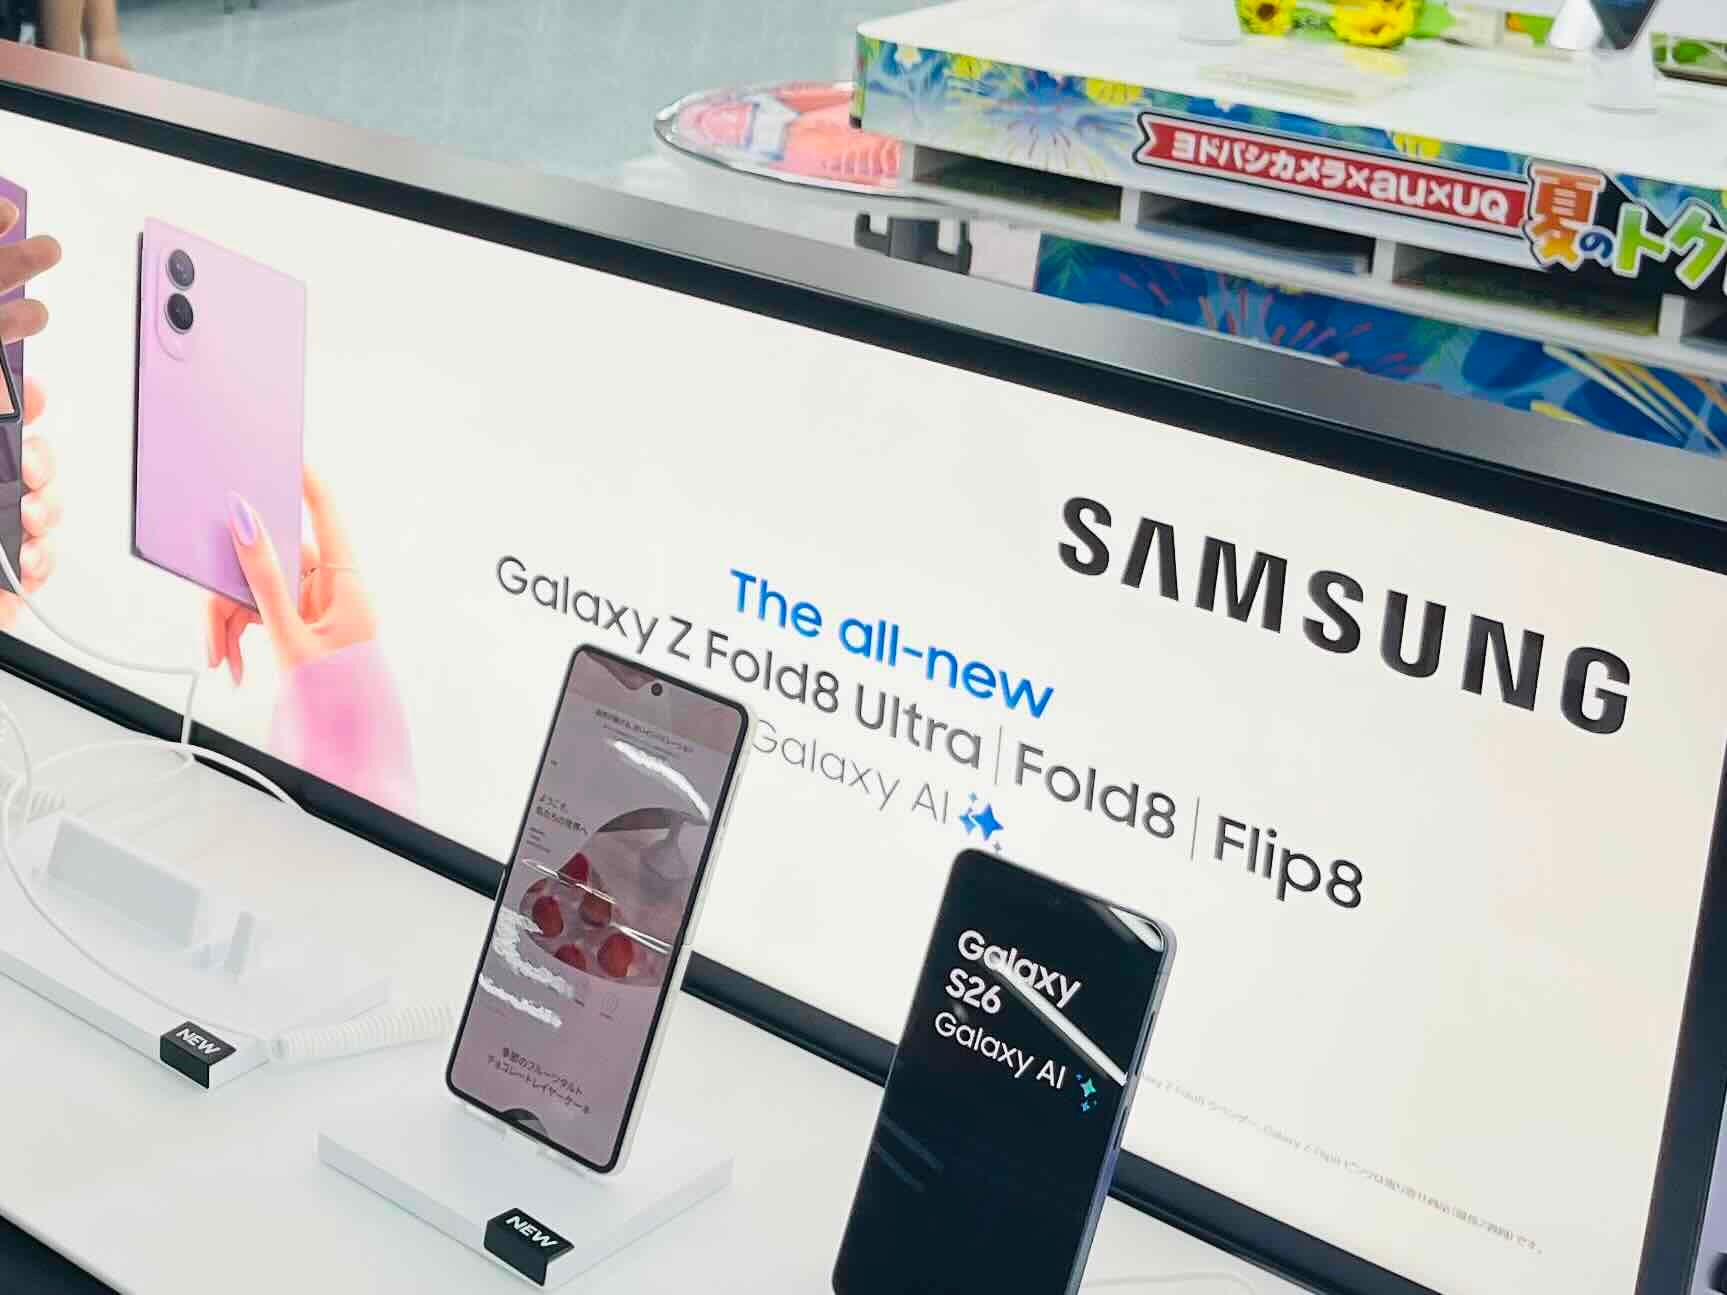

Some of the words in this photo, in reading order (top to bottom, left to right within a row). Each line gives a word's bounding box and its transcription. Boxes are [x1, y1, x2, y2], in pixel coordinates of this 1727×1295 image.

[730, 567, 823, 638] The
[838, 616, 1054, 719] all-new
[1057, 493, 1634, 736] SAMSUNG
[496, 555, 658, 655] Galaxy
[668, 615, 692, 661] Z
[705, 629, 839, 714] Fold8
[855, 684, 981, 769] Ultra
[1014, 741, 1176, 840] Fold8
[1213, 814, 1363, 910] Flip8
[751, 719, 901, 811] Galaxy
[911, 782, 950, 825] AI
[945, 968, 1001, 1015] S26
[958, 930, 1081, 1009] Galaxy
[175, 1026, 220, 1057] NEW
[934, 1012, 1034, 1079] Galaxy
[1036, 1060, 1066, 1090] AI
[506, 1214, 558, 1250] NEW
